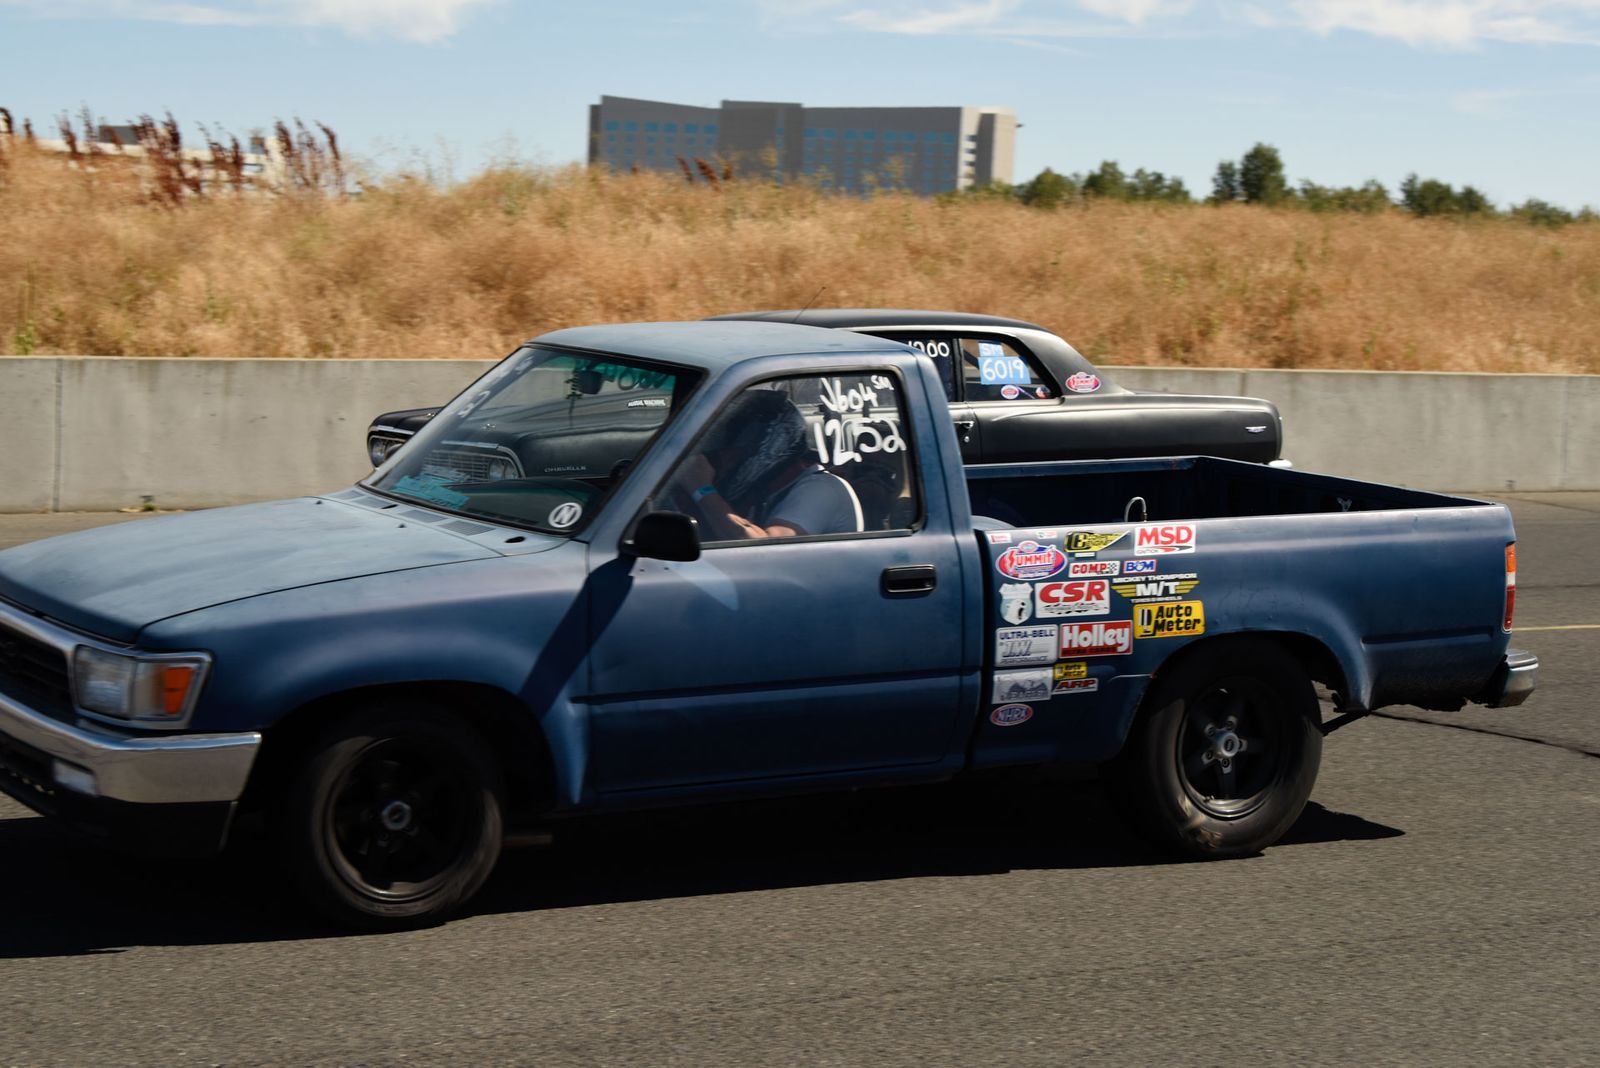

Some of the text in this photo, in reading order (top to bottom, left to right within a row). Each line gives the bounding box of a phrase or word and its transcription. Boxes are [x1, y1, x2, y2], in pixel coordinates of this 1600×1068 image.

[983, 357, 1025, 381] 6019
[1137, 525, 1193, 547] MSD
[1072, 563, 1107, 575] COMP
[1039, 581, 1106, 604] CSR
[1135, 580, 1181, 597] M/T
[1155, 604, 1193, 619] Auto
[1154, 617, 1201, 633] Meter
[1062, 623, 1130, 653] Holley
[1055, 679, 1096, 689] ARP
